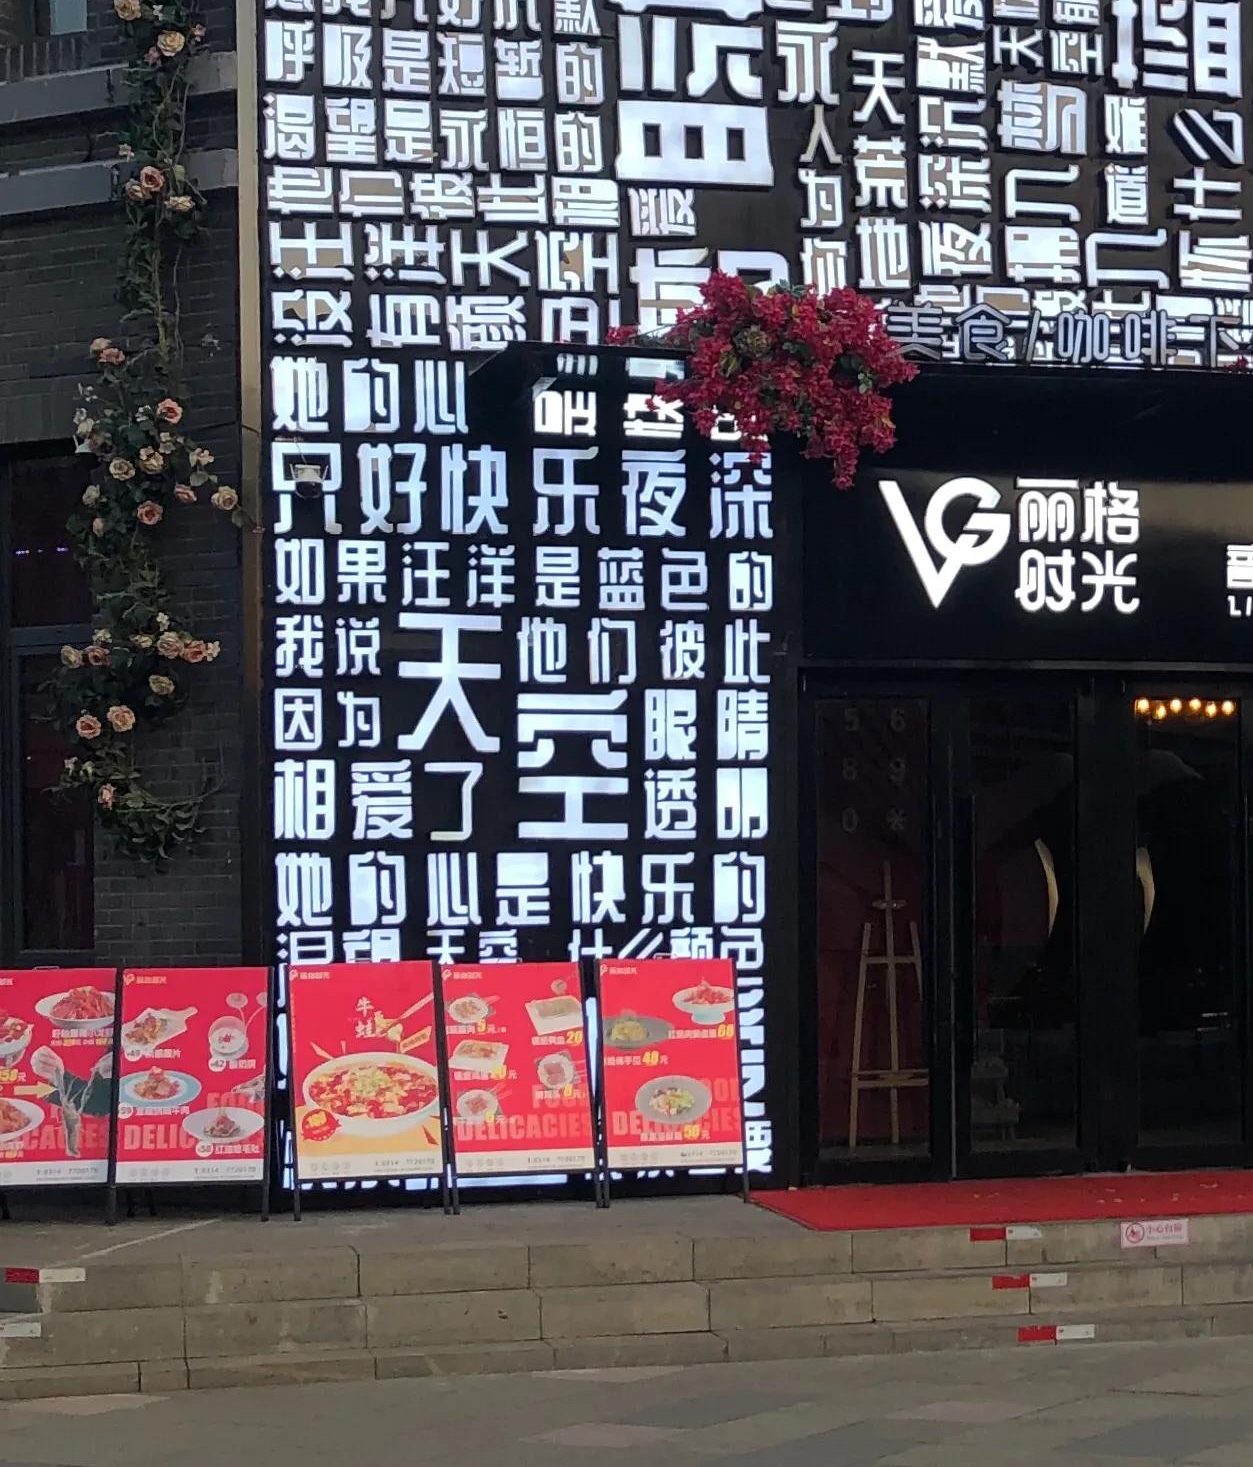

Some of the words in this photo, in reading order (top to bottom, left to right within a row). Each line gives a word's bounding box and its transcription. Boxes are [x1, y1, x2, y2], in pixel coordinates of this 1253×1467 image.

[265, 19, 603, 104] 呼吸是短暂的
[263, 94, 602, 172] 渴望是永恒的
[272, 442, 772, 538] 只好快乐夜深
[1015, 477, 1142, 546] 丽格
[275, 539, 772, 610] 如果汪洋是蓝色的
[1014, 549, 1142, 614] 时光
[275, 851, 764, 926] 她的心是快乐的
